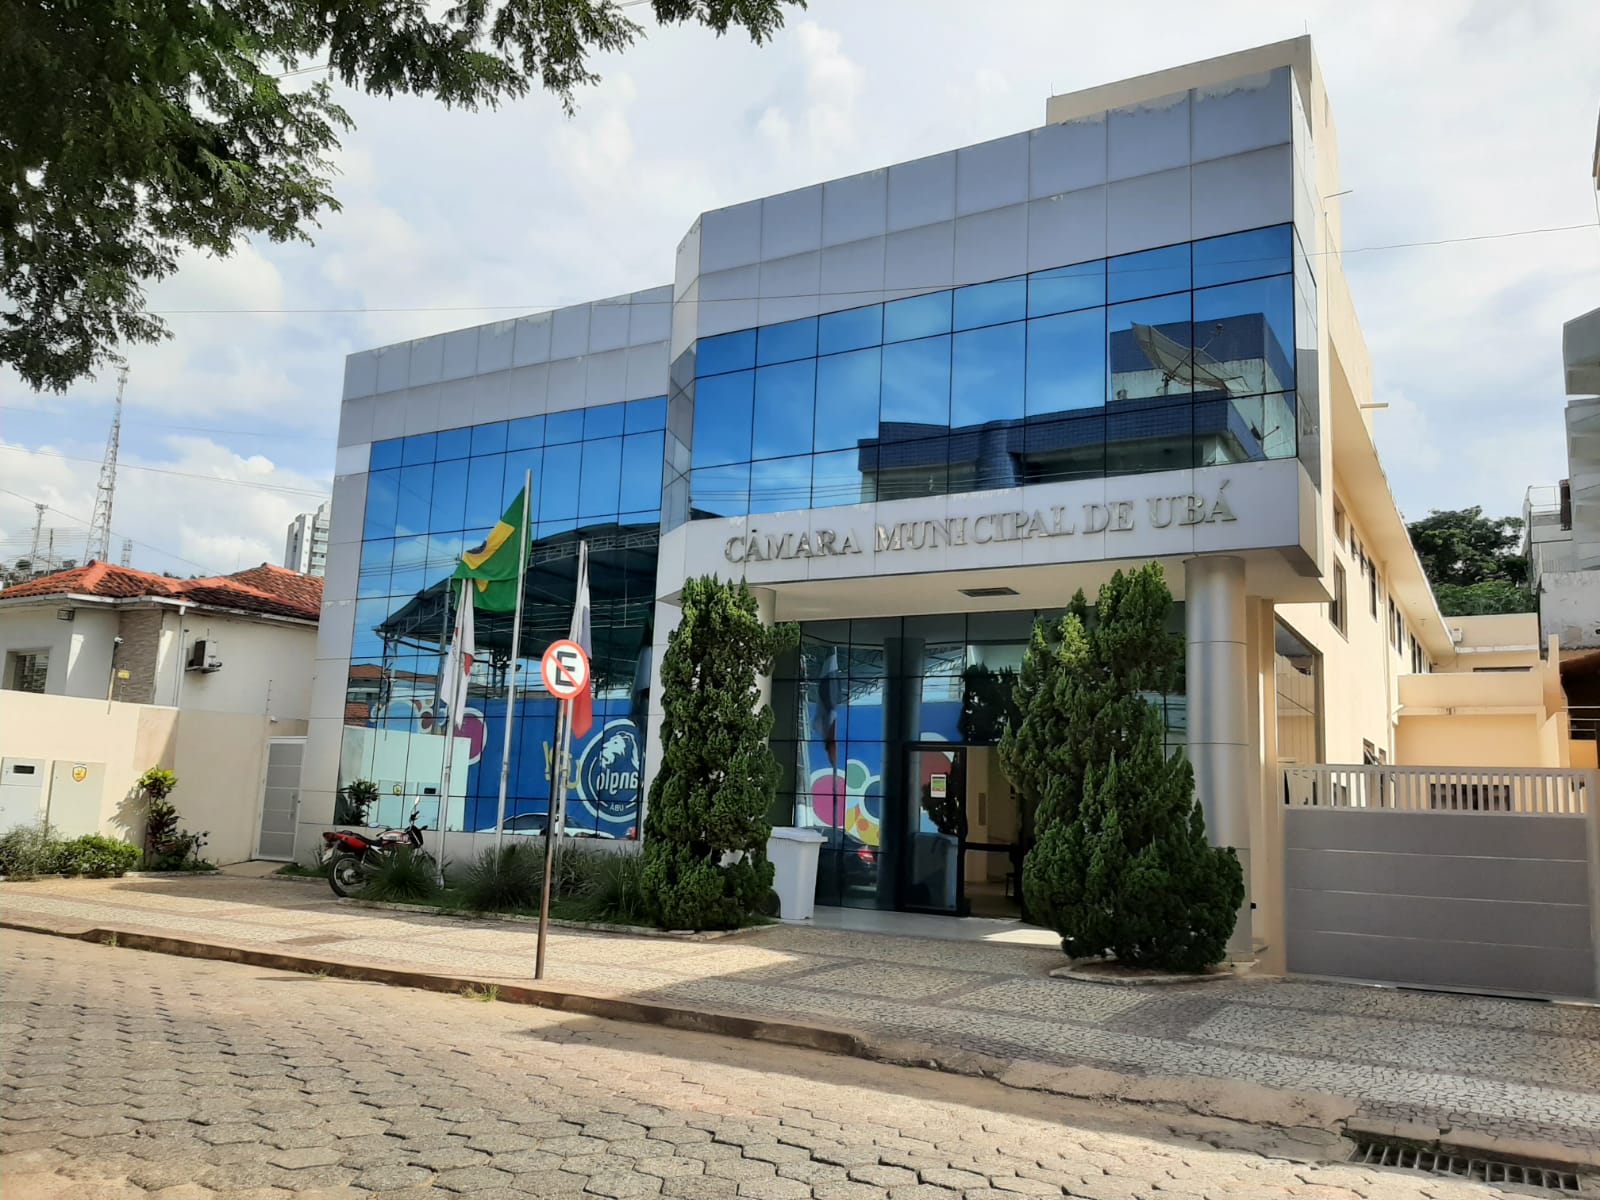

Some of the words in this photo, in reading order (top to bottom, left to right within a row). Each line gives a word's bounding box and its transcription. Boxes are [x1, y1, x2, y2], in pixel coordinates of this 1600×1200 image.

[874, 506, 1075, 552] MUNICIPAL
[1082, 501, 1134, 534] DE
[1147, 479, 1237, 528] UBÁ
[555, 651, 578, 687] E
